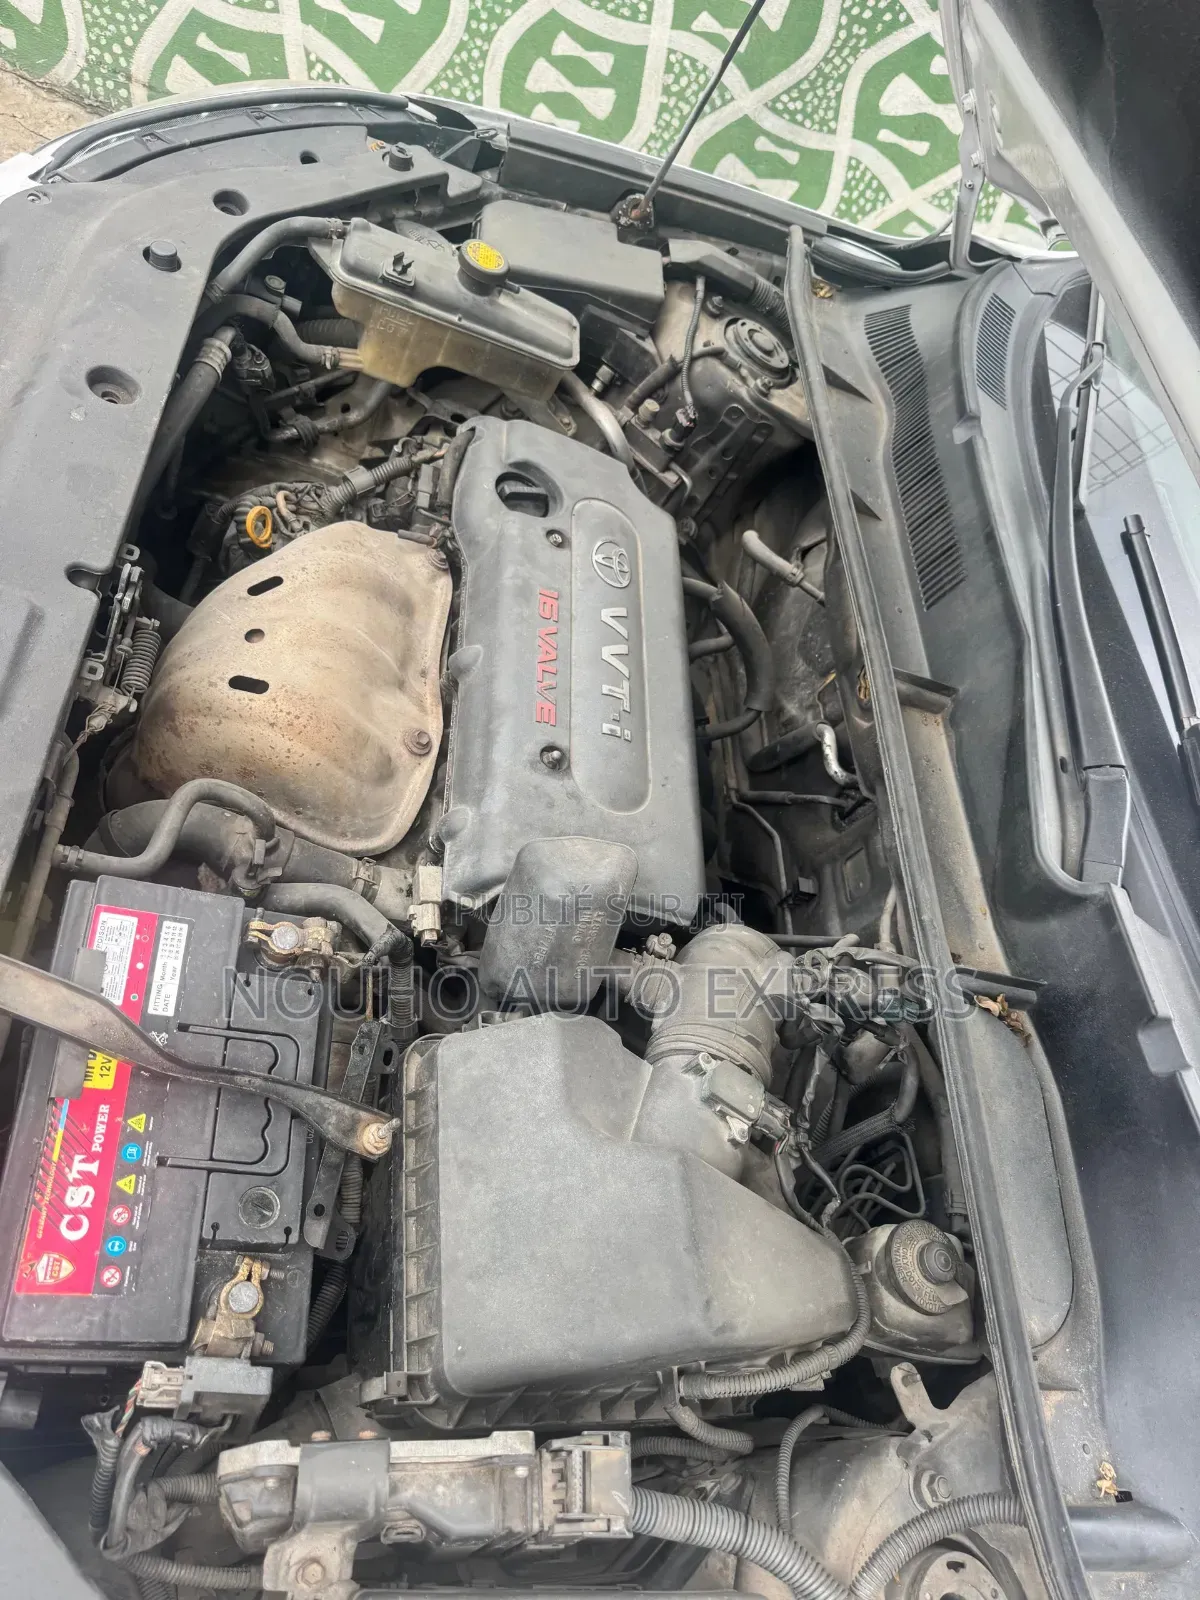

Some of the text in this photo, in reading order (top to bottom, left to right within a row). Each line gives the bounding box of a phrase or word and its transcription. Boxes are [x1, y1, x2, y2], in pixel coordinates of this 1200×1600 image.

[535, 588, 559, 726] 16 VALVE
[601, 607, 632, 743] VVT-i
[95, 920, 107, 949] POISON
[152, 984, 163, 1011] FITTING
[162, 994, 171, 1012] DATE
[99, 1056, 112, 1078] 12V
[60, 1104, 110, 1241] CST POWER
[36, 1162, 56, 1238] GERMANY TECHNOLOGY
[53, 1261, 61, 1277] CST
[893, 1238, 908, 1283] CONTAINER
